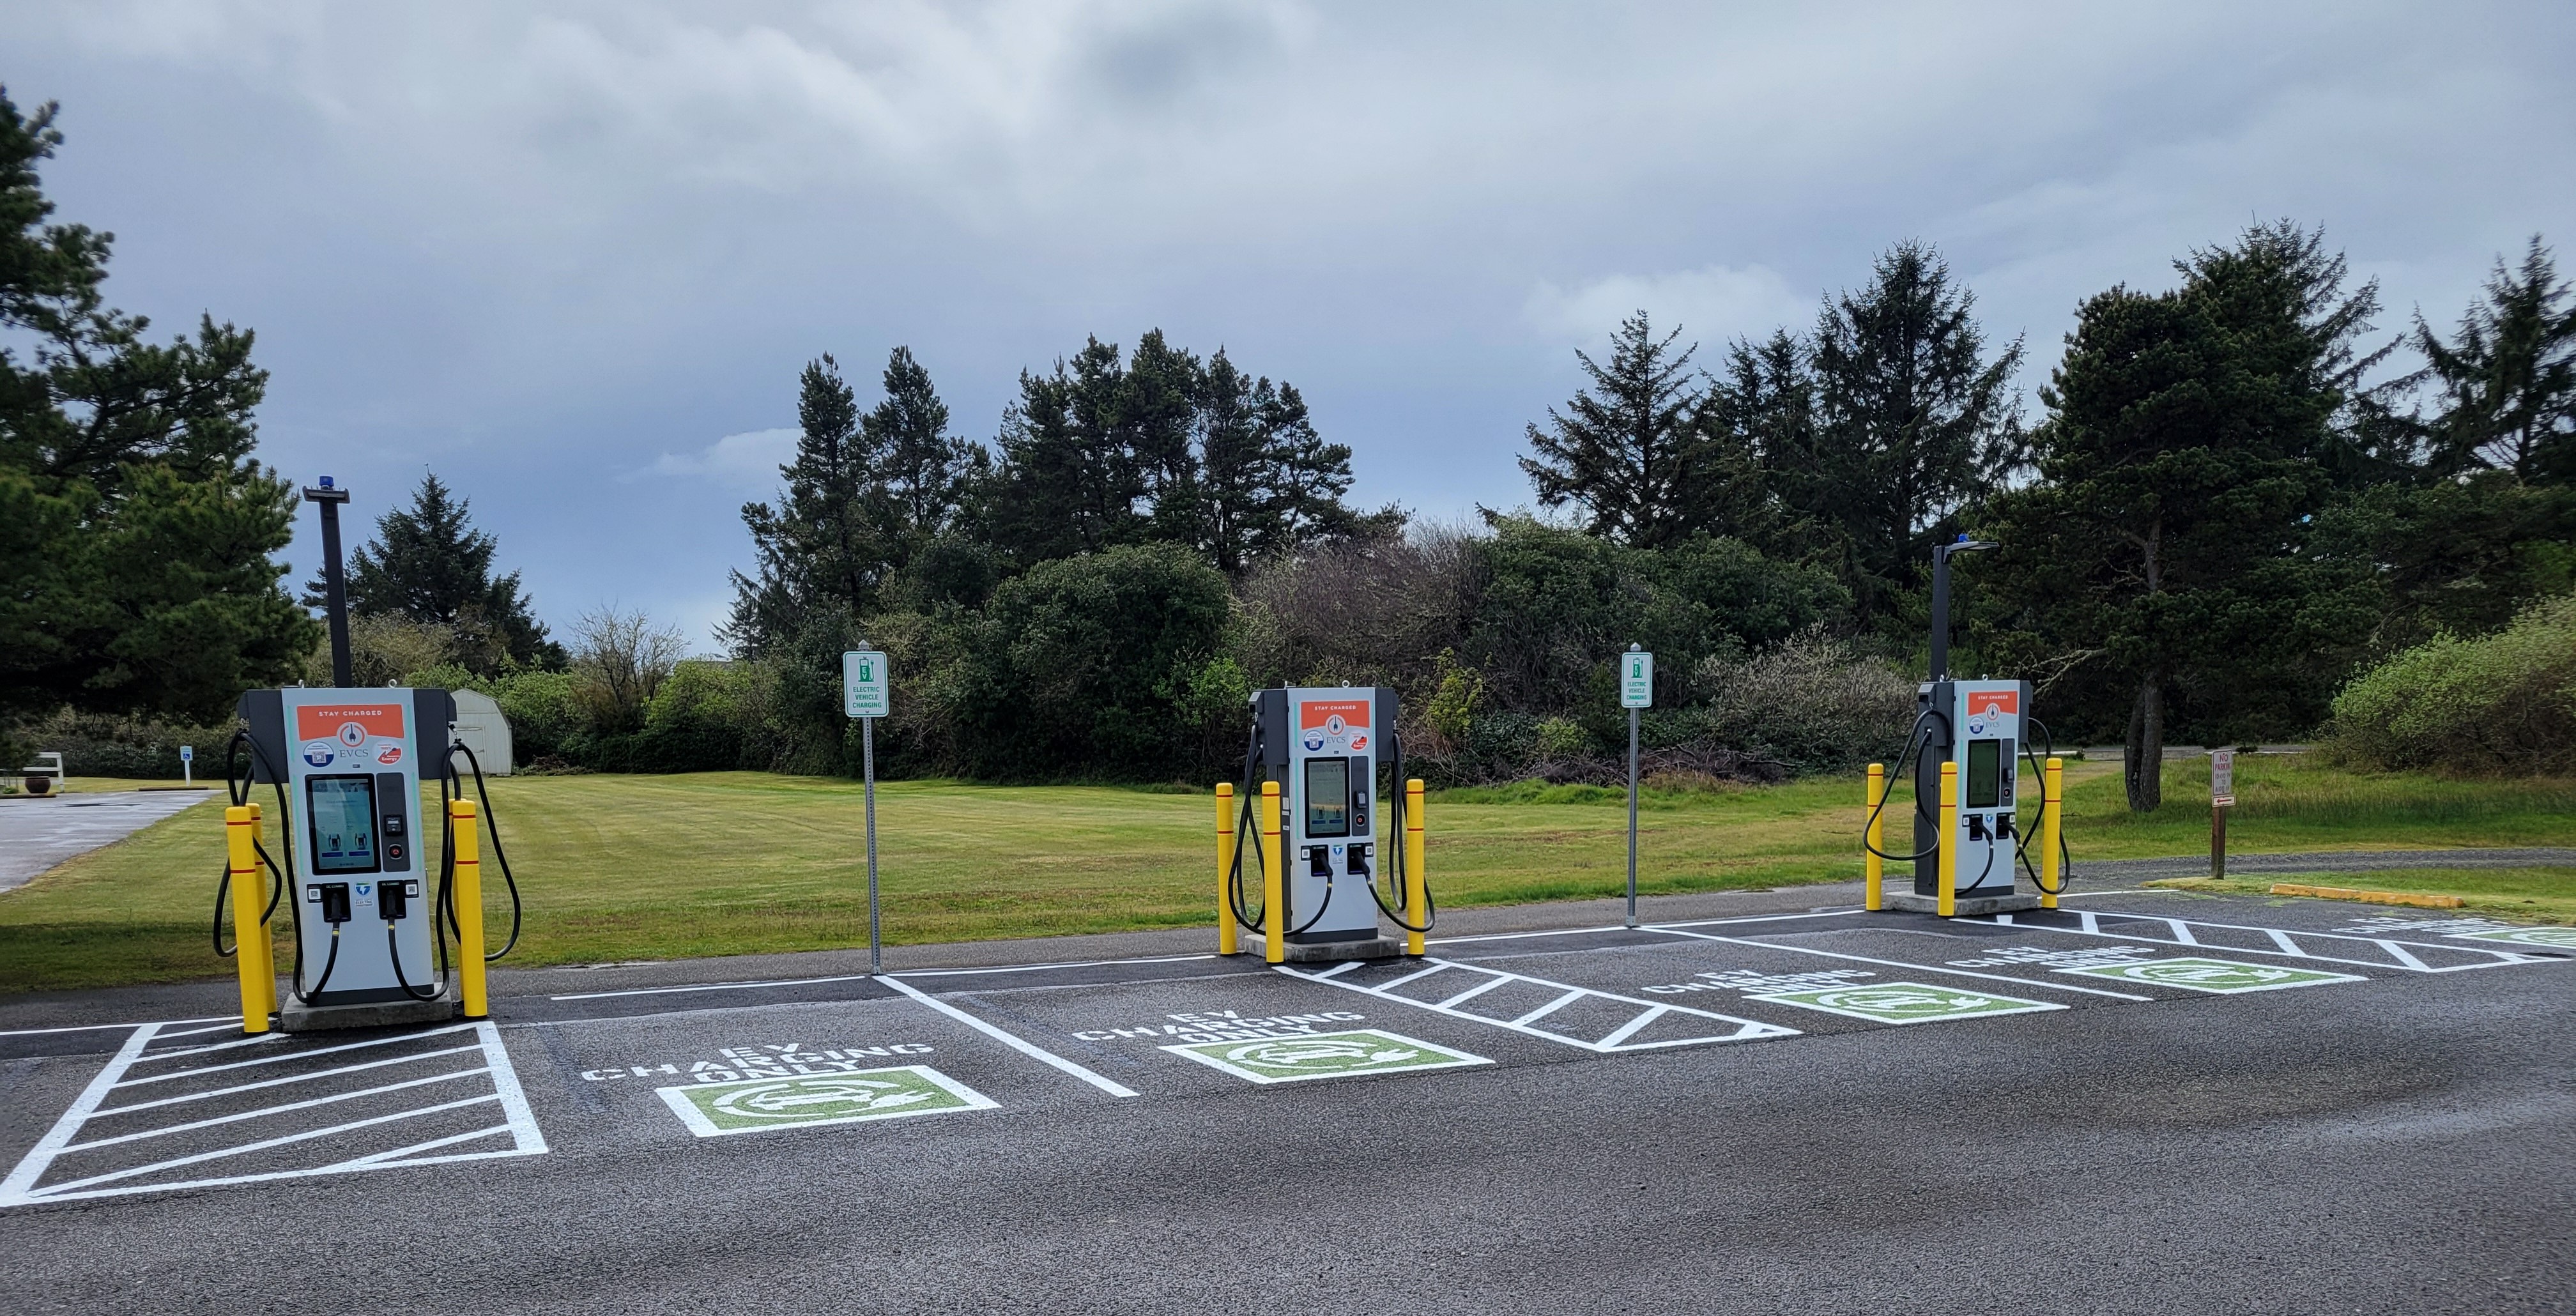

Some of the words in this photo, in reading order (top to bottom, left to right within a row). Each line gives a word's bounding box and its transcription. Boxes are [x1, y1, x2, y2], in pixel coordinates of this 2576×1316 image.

[339, 749, 369, 758] EVCS
[2220, 754, 2228, 762] NO
[1641, 969, 1876, 994] CHARGING
[1694, 970, 1763, 980] EV
[1166, 1010, 1239, 1022] EV
[1071, 1011, 1365, 1041] CHARGING
[1178, 1025, 1321, 1042] ONLY
[718, 1043, 799, 1058] EV
[581, 1044, 935, 1081] CHARGING
[694, 1059, 859, 1083] ONLY
